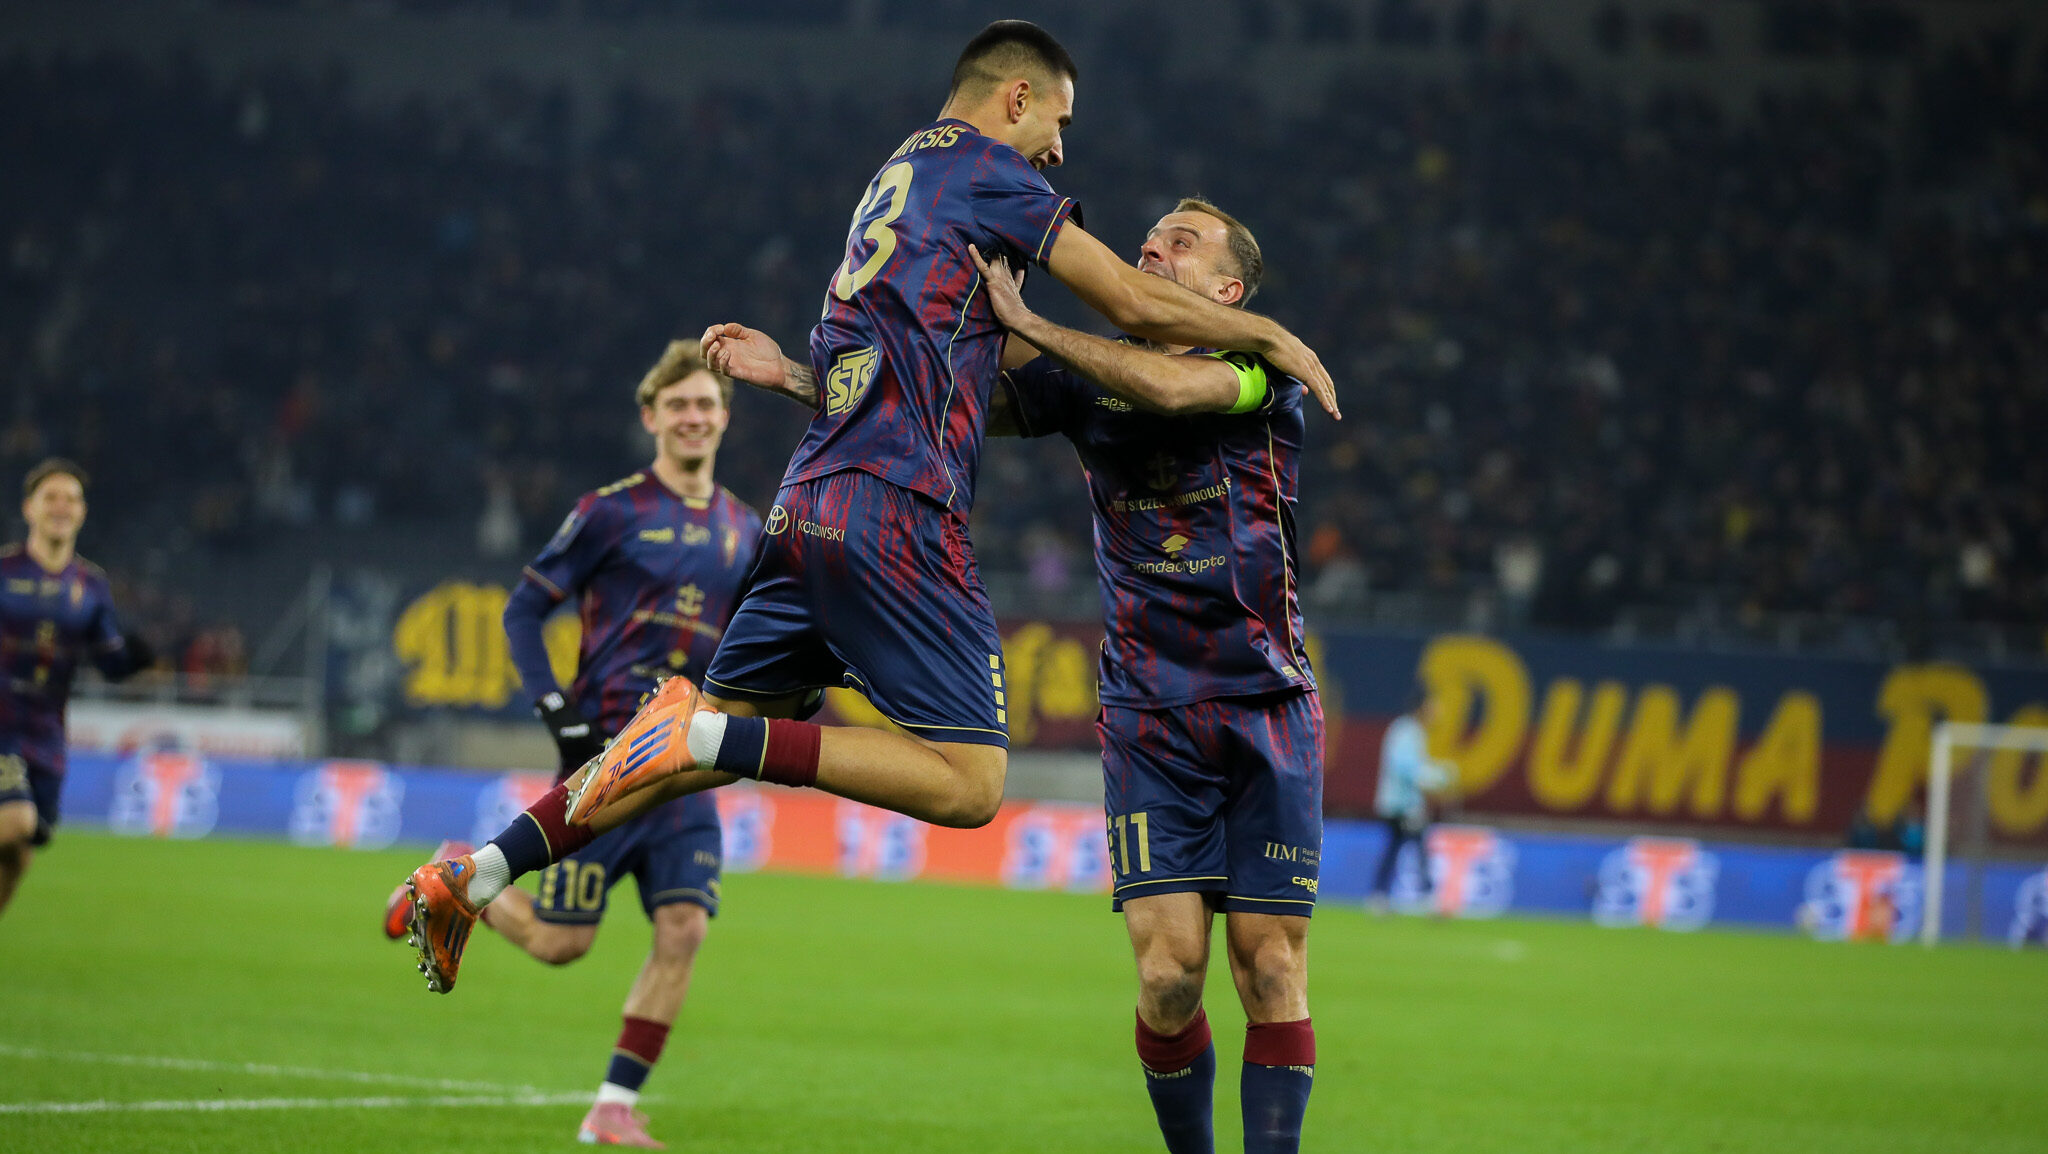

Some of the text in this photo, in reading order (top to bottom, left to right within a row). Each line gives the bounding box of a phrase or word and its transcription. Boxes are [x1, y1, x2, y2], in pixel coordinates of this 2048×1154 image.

[827, 345, 879, 416] STS
[1418, 634, 1822, 822] DUMA
[1116, 812, 1151, 875] 11
[562, 858, 606, 911] 10
